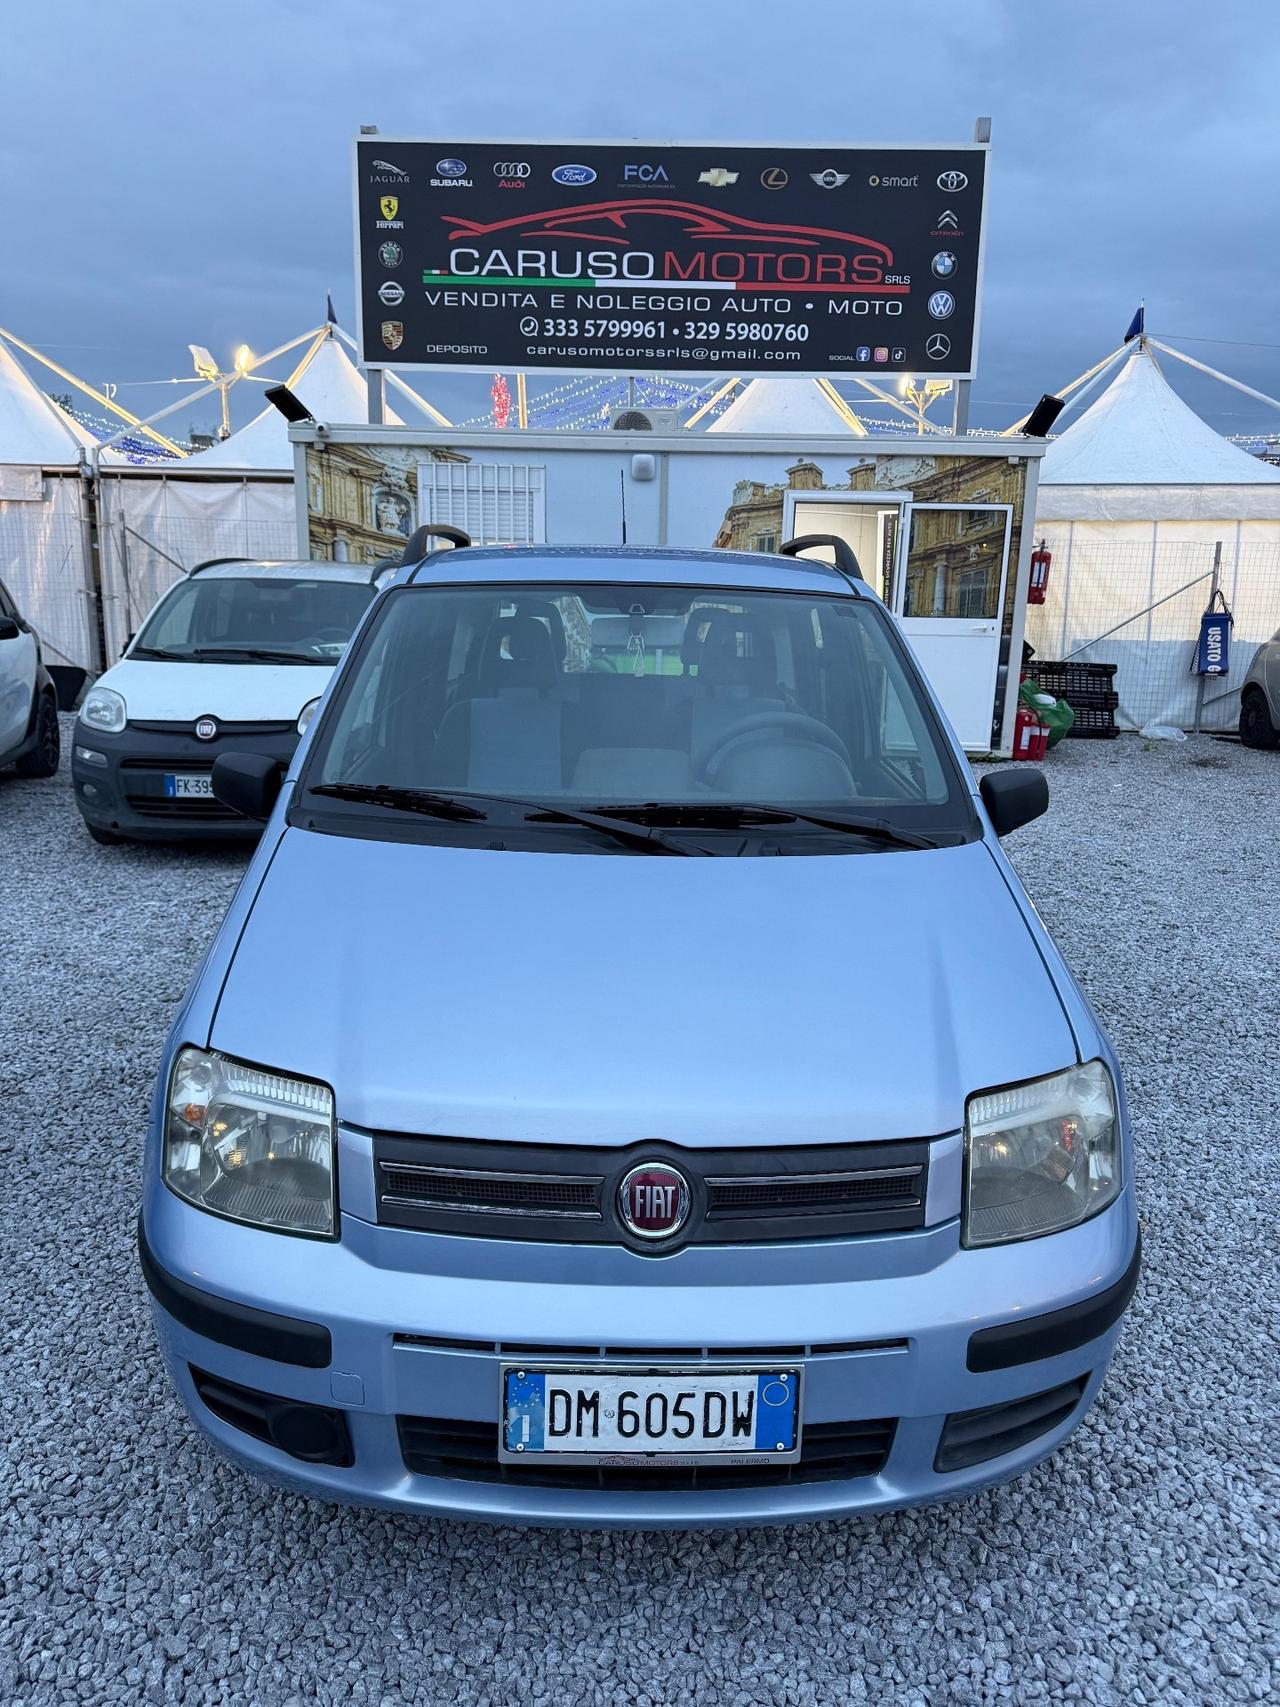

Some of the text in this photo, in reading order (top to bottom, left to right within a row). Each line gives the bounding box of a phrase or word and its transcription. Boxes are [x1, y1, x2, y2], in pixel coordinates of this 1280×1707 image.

[370, 175, 410, 183] JAGUAR
[562, 169, 586, 181] Ford
[624, 164, 669, 181] FCA
[430, 179, 473, 187] SUBARU
[498, 180, 526, 188] Audi
[882, 176, 918, 187] smart
[450, 248, 911, 285] CARUSO MOTORS SRLS
[425, 291, 903, 316] VENDITA E NOLEGGIO AUTO MOTO
[544, 319, 809, 341] 333 5799961 329 5980760
[426, 344, 488, 354] DEPOSITO
[526, 346, 801, 361] carusomotorssrls@gmail.com
[1207, 627, 1222, 662] USATO
[177, 779, 191, 793] FK
[635, 1185, 676, 1219] FIAT
[549, 1389, 599, 1438] DM
